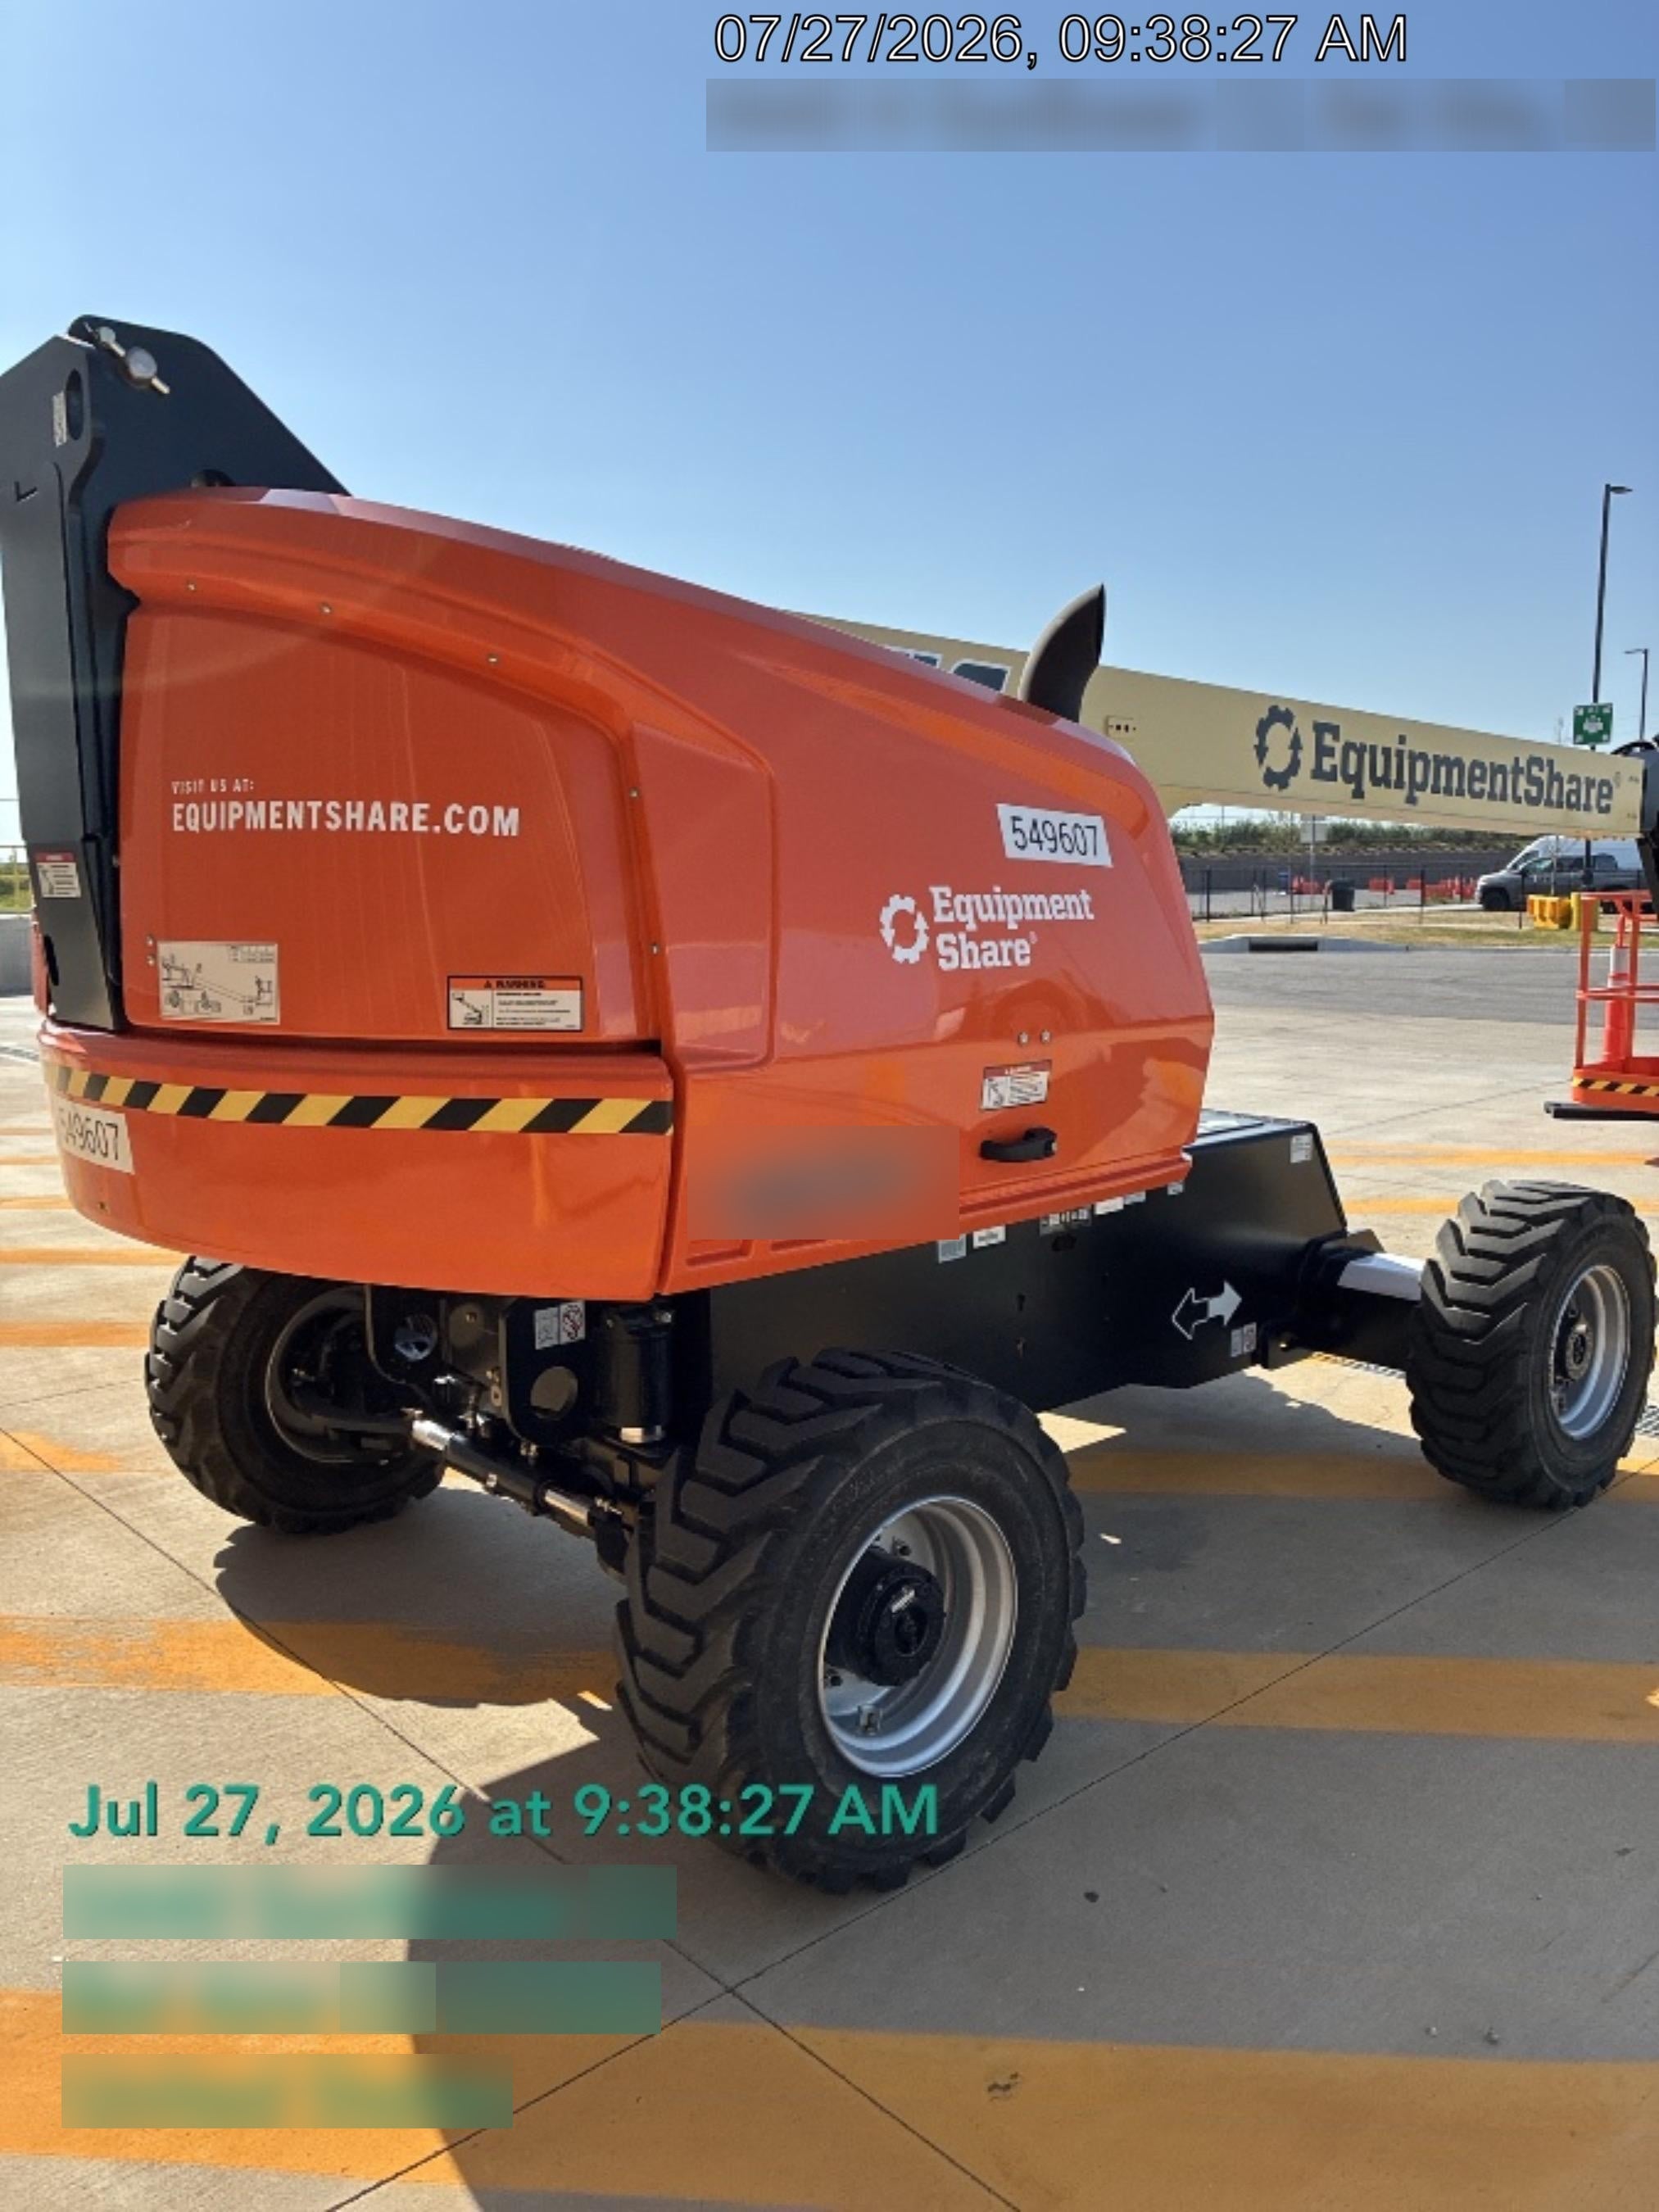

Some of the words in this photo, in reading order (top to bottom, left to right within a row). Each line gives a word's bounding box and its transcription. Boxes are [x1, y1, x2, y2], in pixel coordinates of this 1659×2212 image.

[1311, 720, 1614, 814] EquipmentShare
[172, 800, 520, 836] EQUIPMENTSHARE.COM
[1010, 815, 1098, 856] 549607
[929, 885, 1095, 931] Equipment
